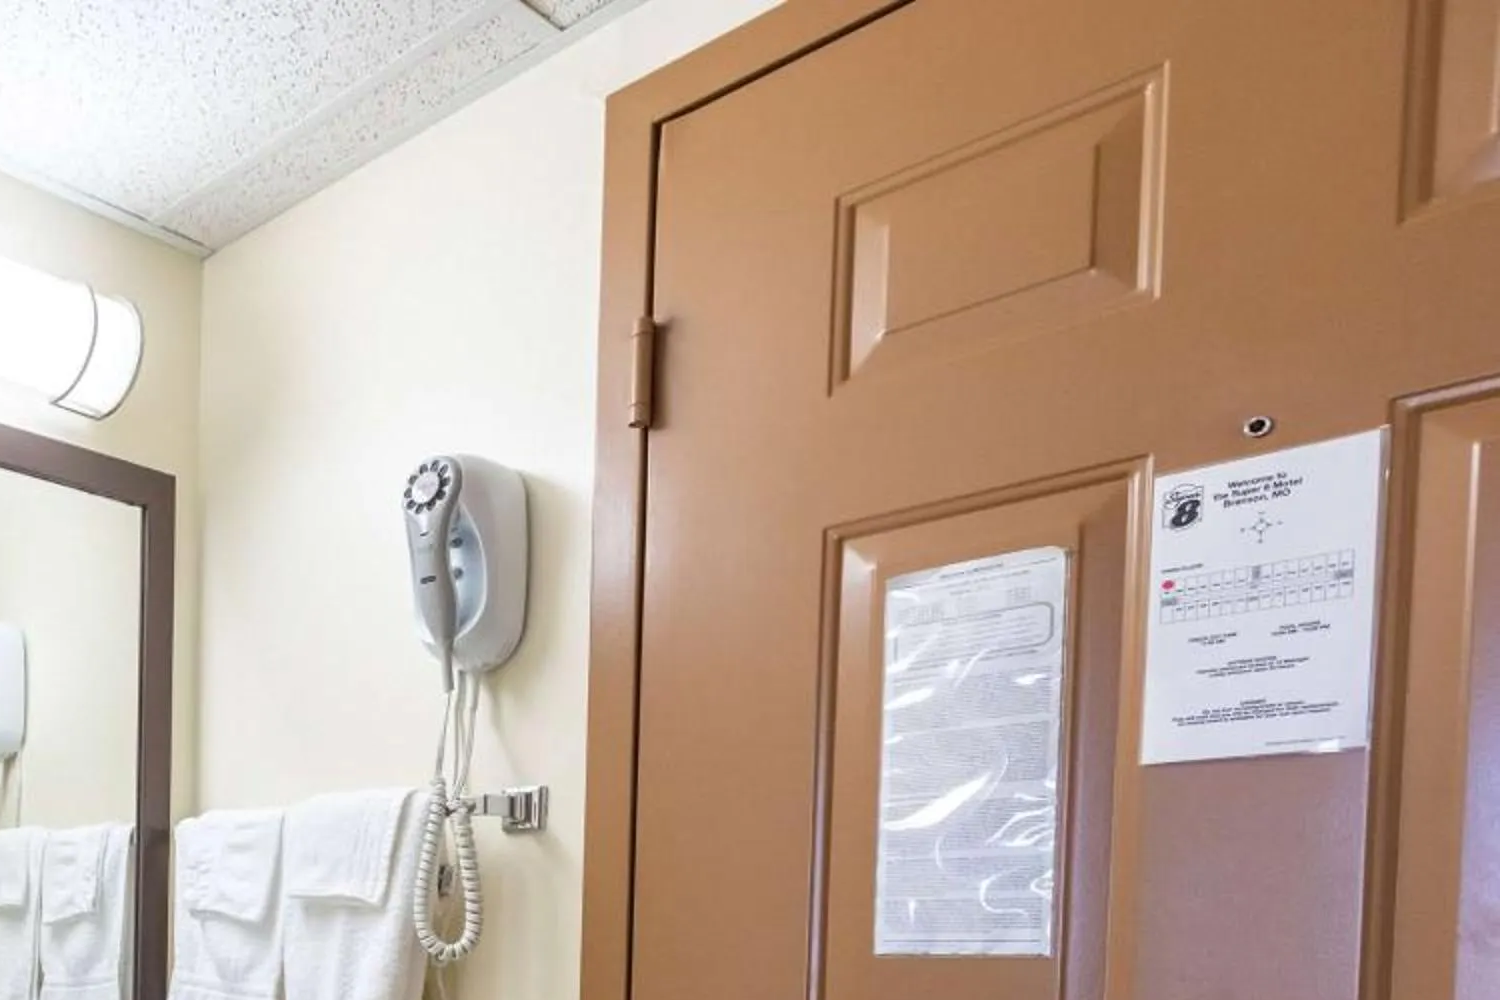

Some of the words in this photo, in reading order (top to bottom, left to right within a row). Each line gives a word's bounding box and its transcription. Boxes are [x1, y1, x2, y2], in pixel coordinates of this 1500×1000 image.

[1227, 475, 1274, 489] Welcome
[1232, 485, 1261, 498] Super
[1273, 477, 1303, 489] Motel
[1272, 488, 1291, 499] MO
[1170, 499, 1201, 528] 8
